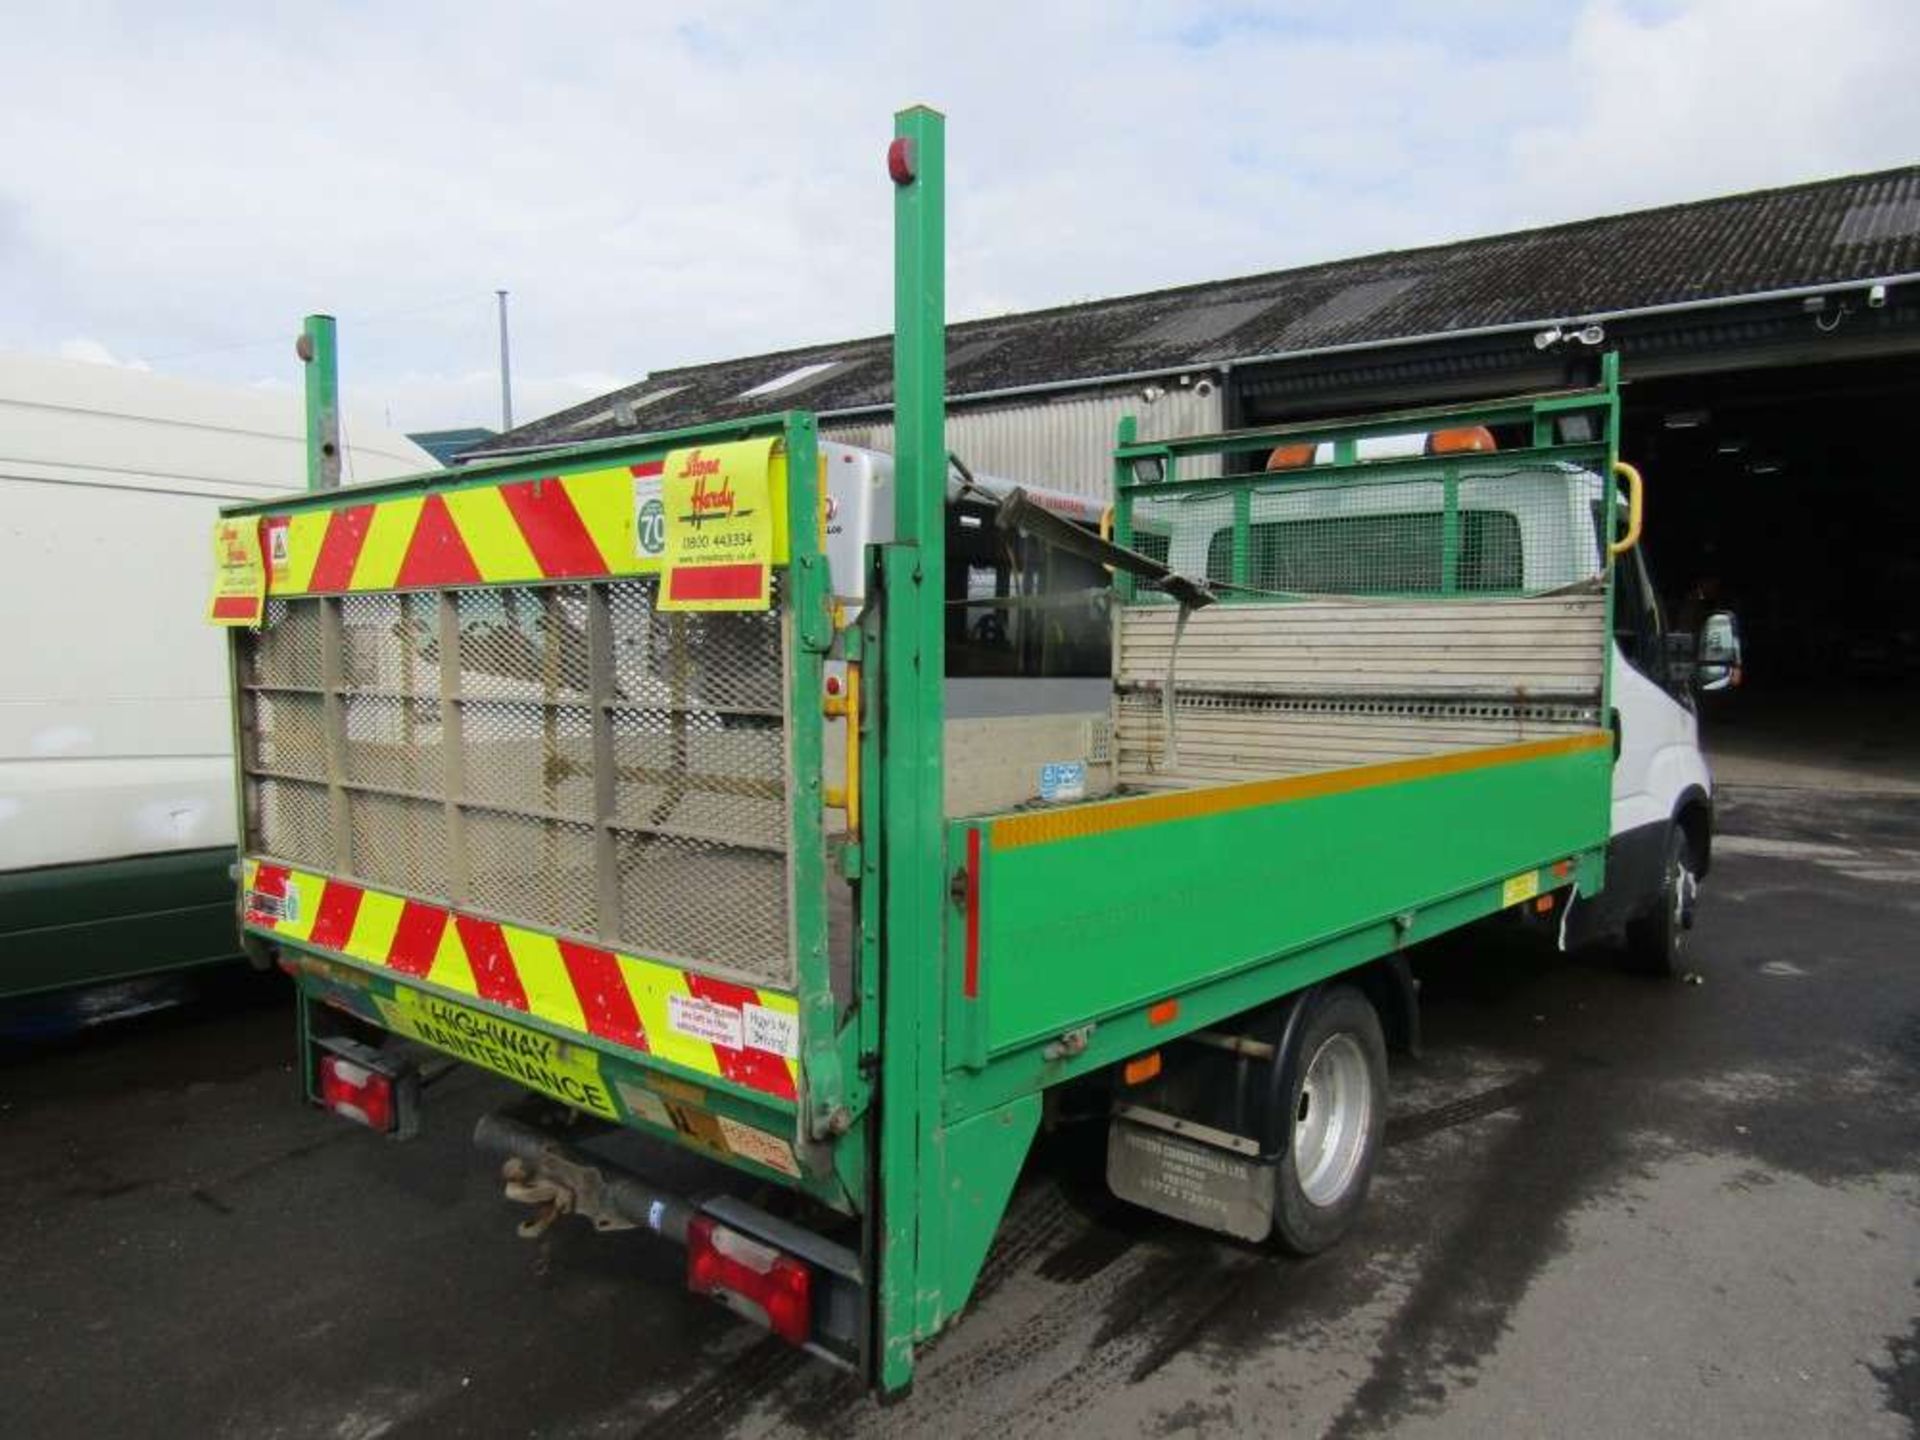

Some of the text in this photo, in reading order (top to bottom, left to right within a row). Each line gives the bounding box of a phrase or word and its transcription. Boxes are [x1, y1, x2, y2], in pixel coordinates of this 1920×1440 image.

[690, 475, 735, 523] Hardy
[641, 514, 665, 545] 70
[431, 1003, 550, 1064] HIGHWAY
[414, 1019, 609, 1111] MAINTENANCE
